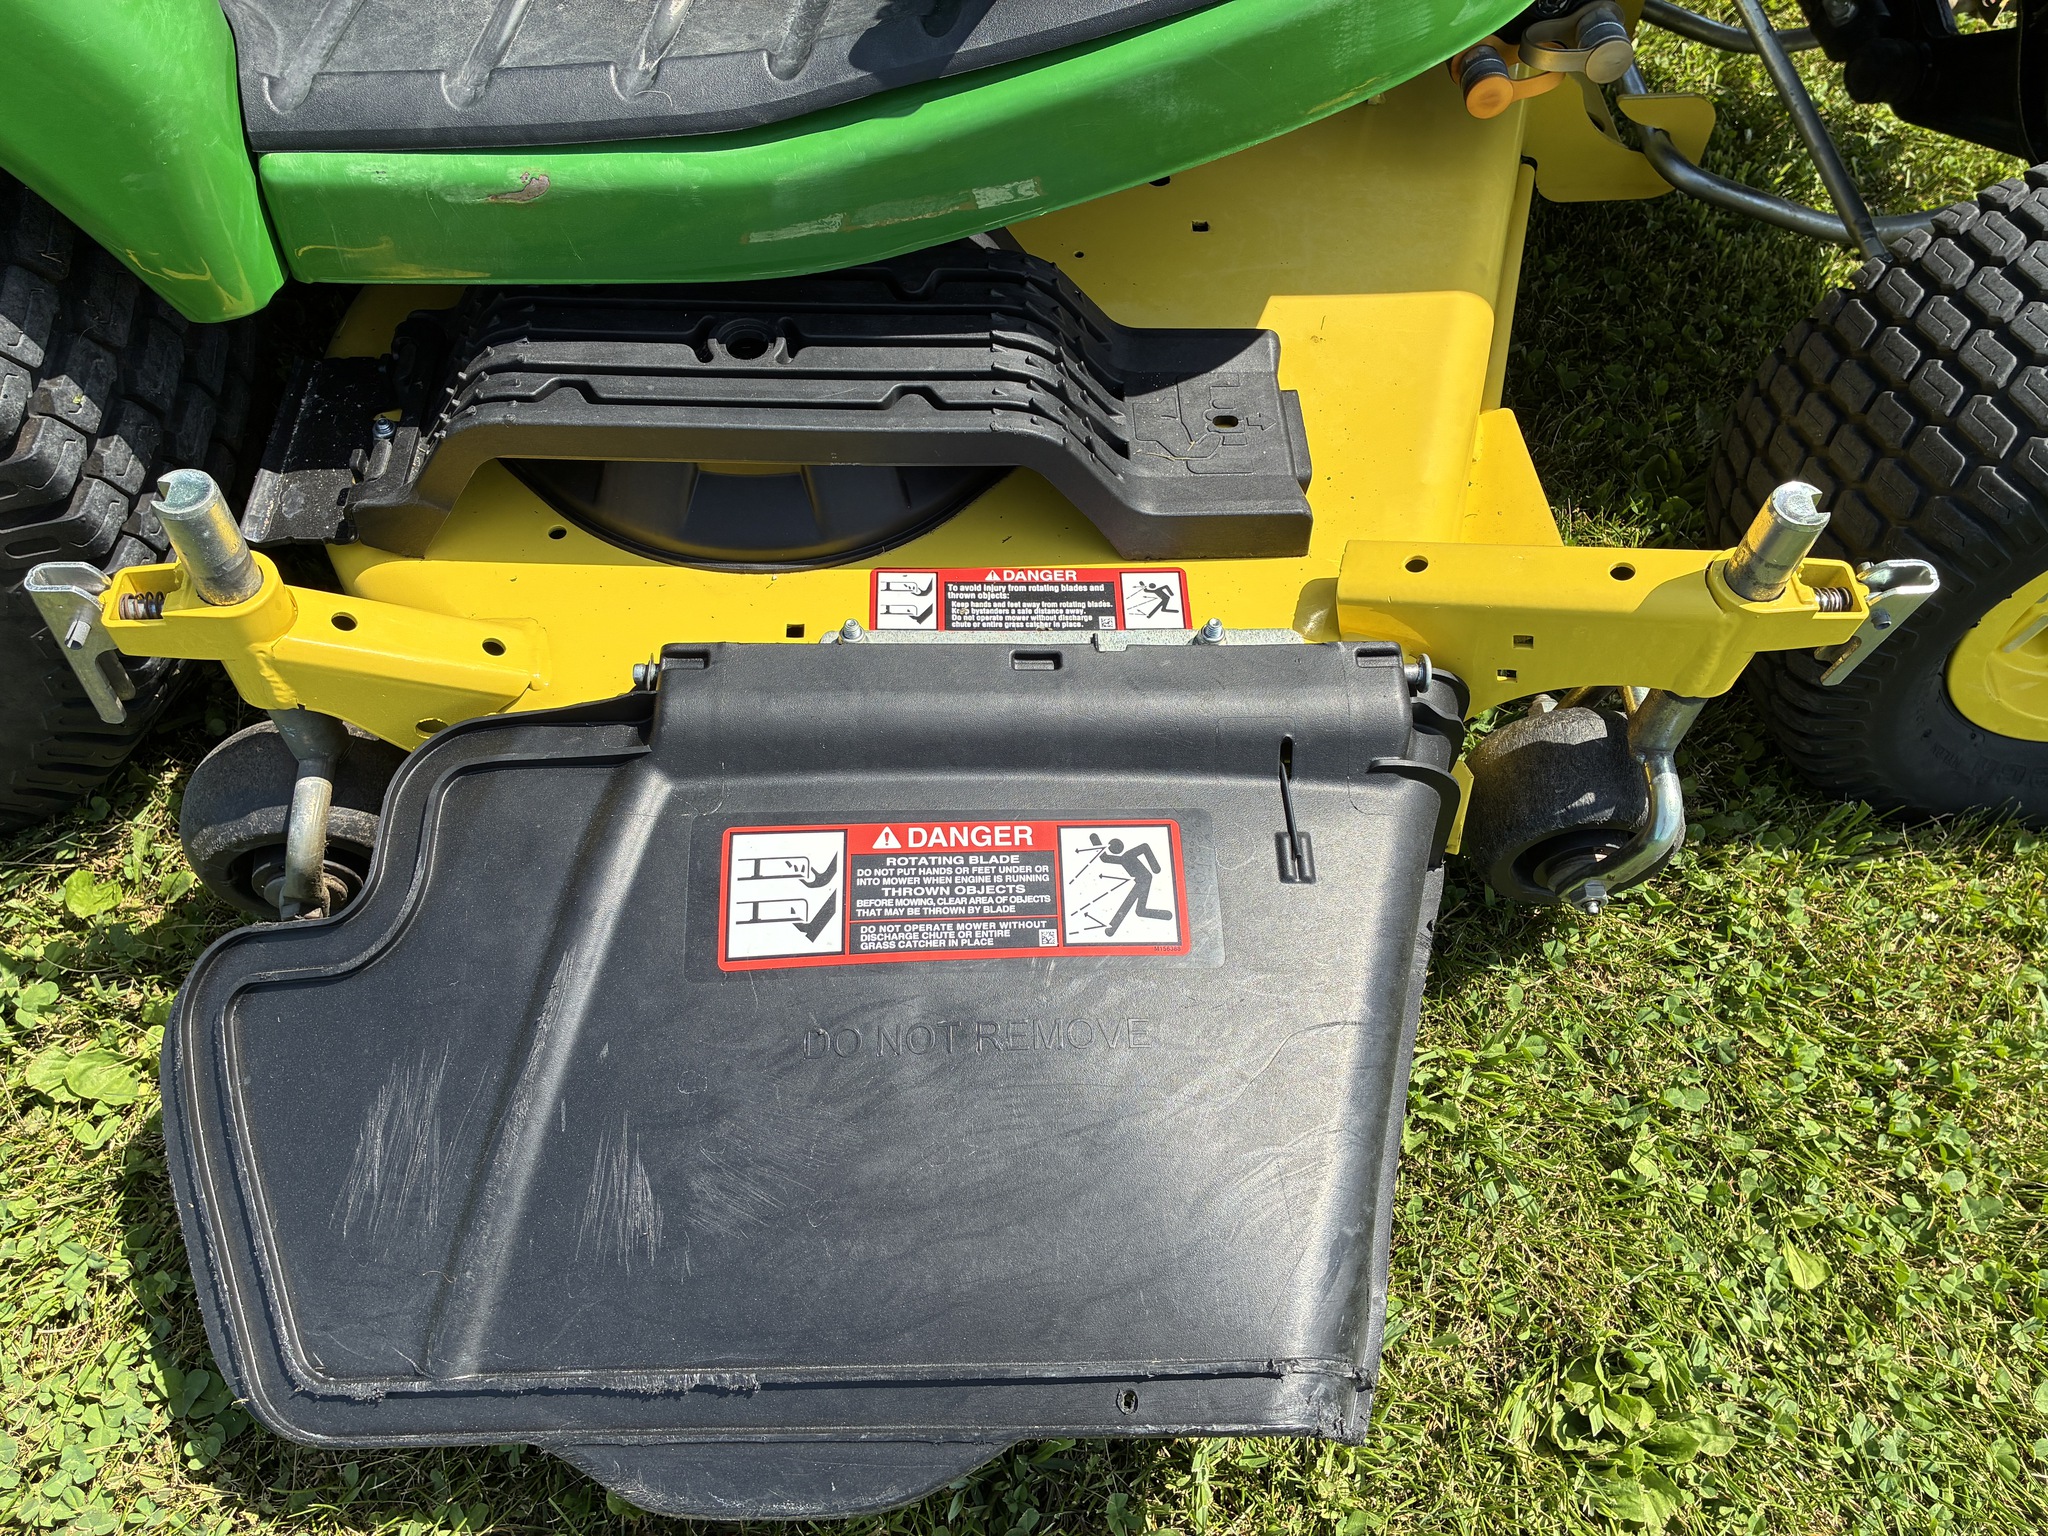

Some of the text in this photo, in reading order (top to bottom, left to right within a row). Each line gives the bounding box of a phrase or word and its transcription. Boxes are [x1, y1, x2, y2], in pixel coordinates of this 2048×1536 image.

[1003, 570, 1077, 581] DANGER
[983, 584, 1006, 592] injury
[1028, 584, 1059, 592] rotating
[978, 592, 1009, 600] objects:
[908, 825, 1033, 848] DANGER
[887, 855, 1020, 866] ROTATING BLADE
[857, 869, 872, 877] DO
[874, 868, 895, 876] NOT
[919, 867, 953, 875] HANDS
[972, 866, 996, 874] FEET
[882, 877, 920, 885] MOWER
[923, 876, 952, 884] WHEN
[955, 875, 991, 883] ENGINE
[1005, 874, 1049, 882] RUNNING
[881, 885, 1026, 896] THROWN OBJECTS
[856, 899, 894, 907] BEFORE
[895, 898, 936, 906] MOWING,
[937, 897, 967, 905] CLEAR
[1009, 895, 1051, 903] OBJECTS
[856, 909, 882, 917] THAT
[884, 908, 905, 916] MAY
[922, 906, 965, 915] THROWN
[983, 905, 1016, 913] BLADE
[879, 925, 901, 933] NOT
[904, 924, 953, 932] OPERATE
[957, 922, 996, 930] MOWER
[999, 921, 1047, 929] WITHOUT
[861, 932, 919, 942] DISCHARGE
[922, 931, 955, 939] CHUTE
[975, 930, 1010, 938] ENTIRE
[860, 938, 994, 950] GRASS CATCHER IN PLACE
[803, 1017, 1151, 1059] DO NOT REMOVE
